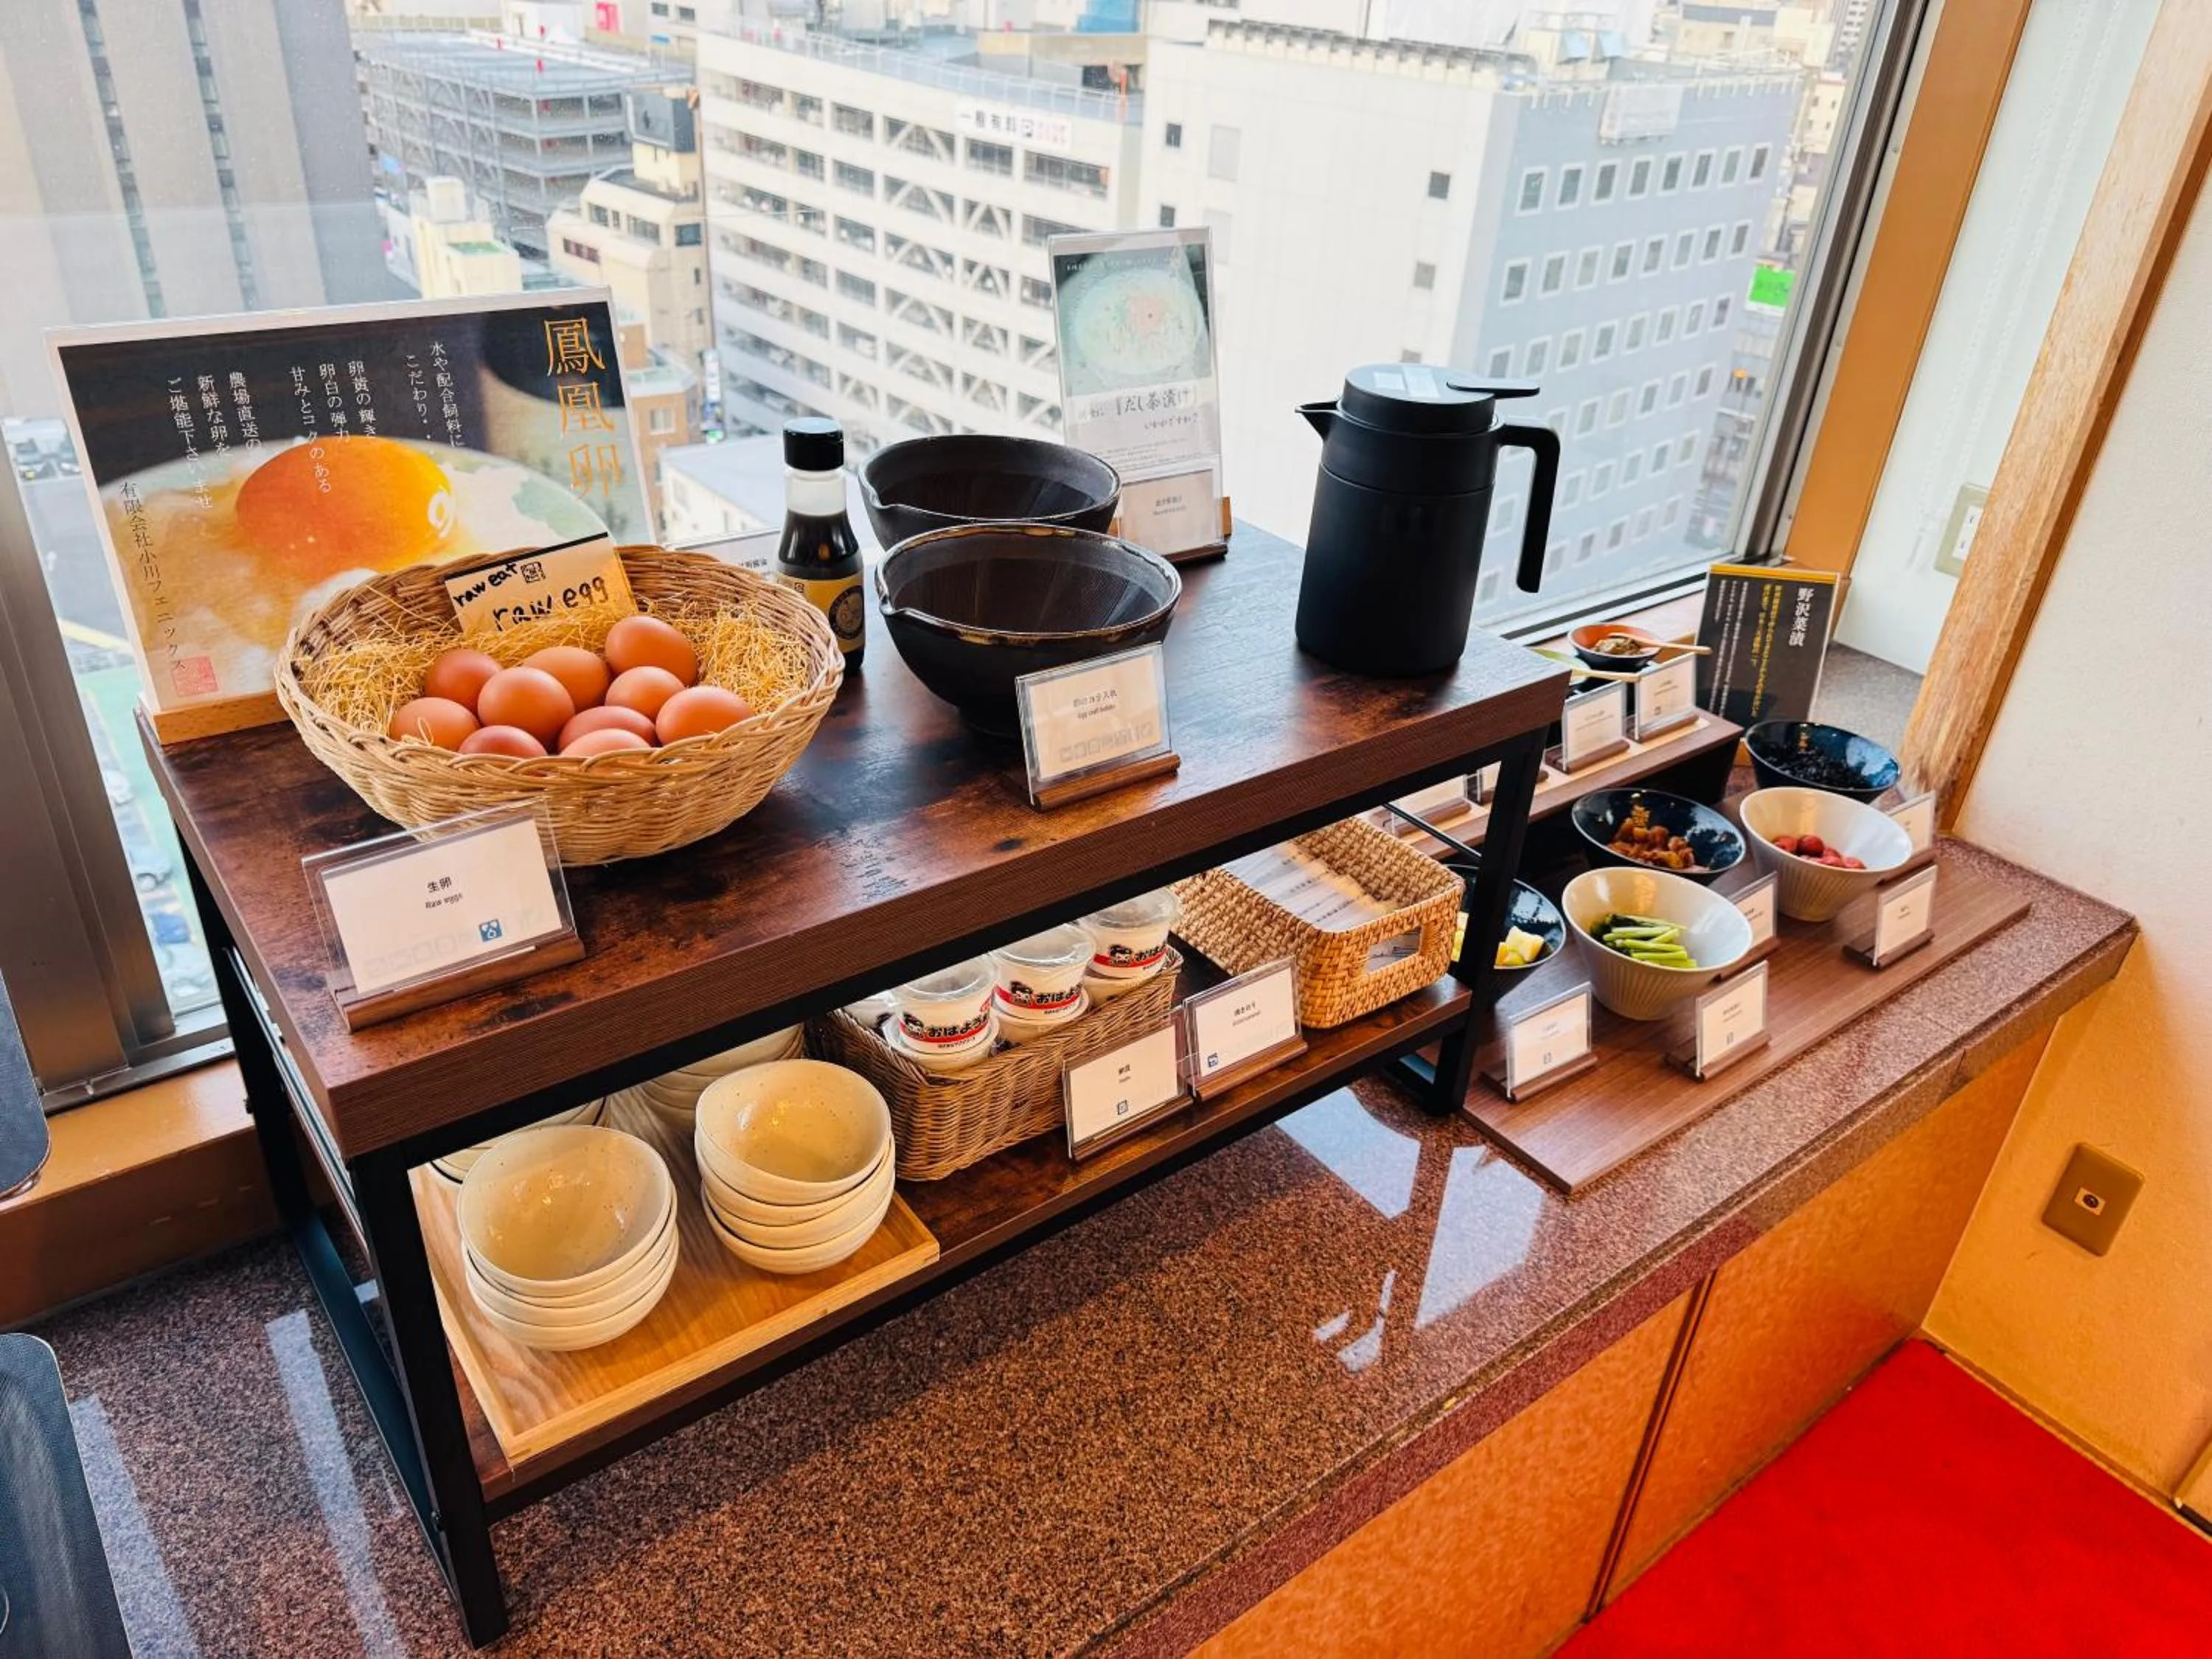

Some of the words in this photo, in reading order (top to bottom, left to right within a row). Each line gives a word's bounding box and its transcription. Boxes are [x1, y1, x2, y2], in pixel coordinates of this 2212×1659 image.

[198, 374, 234, 458] 新鮮な卵を
[229, 371, 262, 450] 農場直送の
[289, 366, 332, 493] 甘みとコクのある
[319, 363, 350, 445] 卵白の弾力
[347, 360, 378, 439] 卵黄の輝き
[431, 341, 462, 448] 水や配合飼料に
[543, 317, 622, 498] 鳳凰卵
[167, 377, 213, 509] ご堪能下さいませ
[120, 481, 186, 669] 有限会社小川フェニックス
[492, 594, 553, 632] raw
[562, 575, 609, 609] egg
[1788, 587, 1815, 647] 野沢菜漬
[425, 900, 442, 908] Raw
[444, 892, 463, 905] eggs
[427, 876, 452, 893] 生卵
